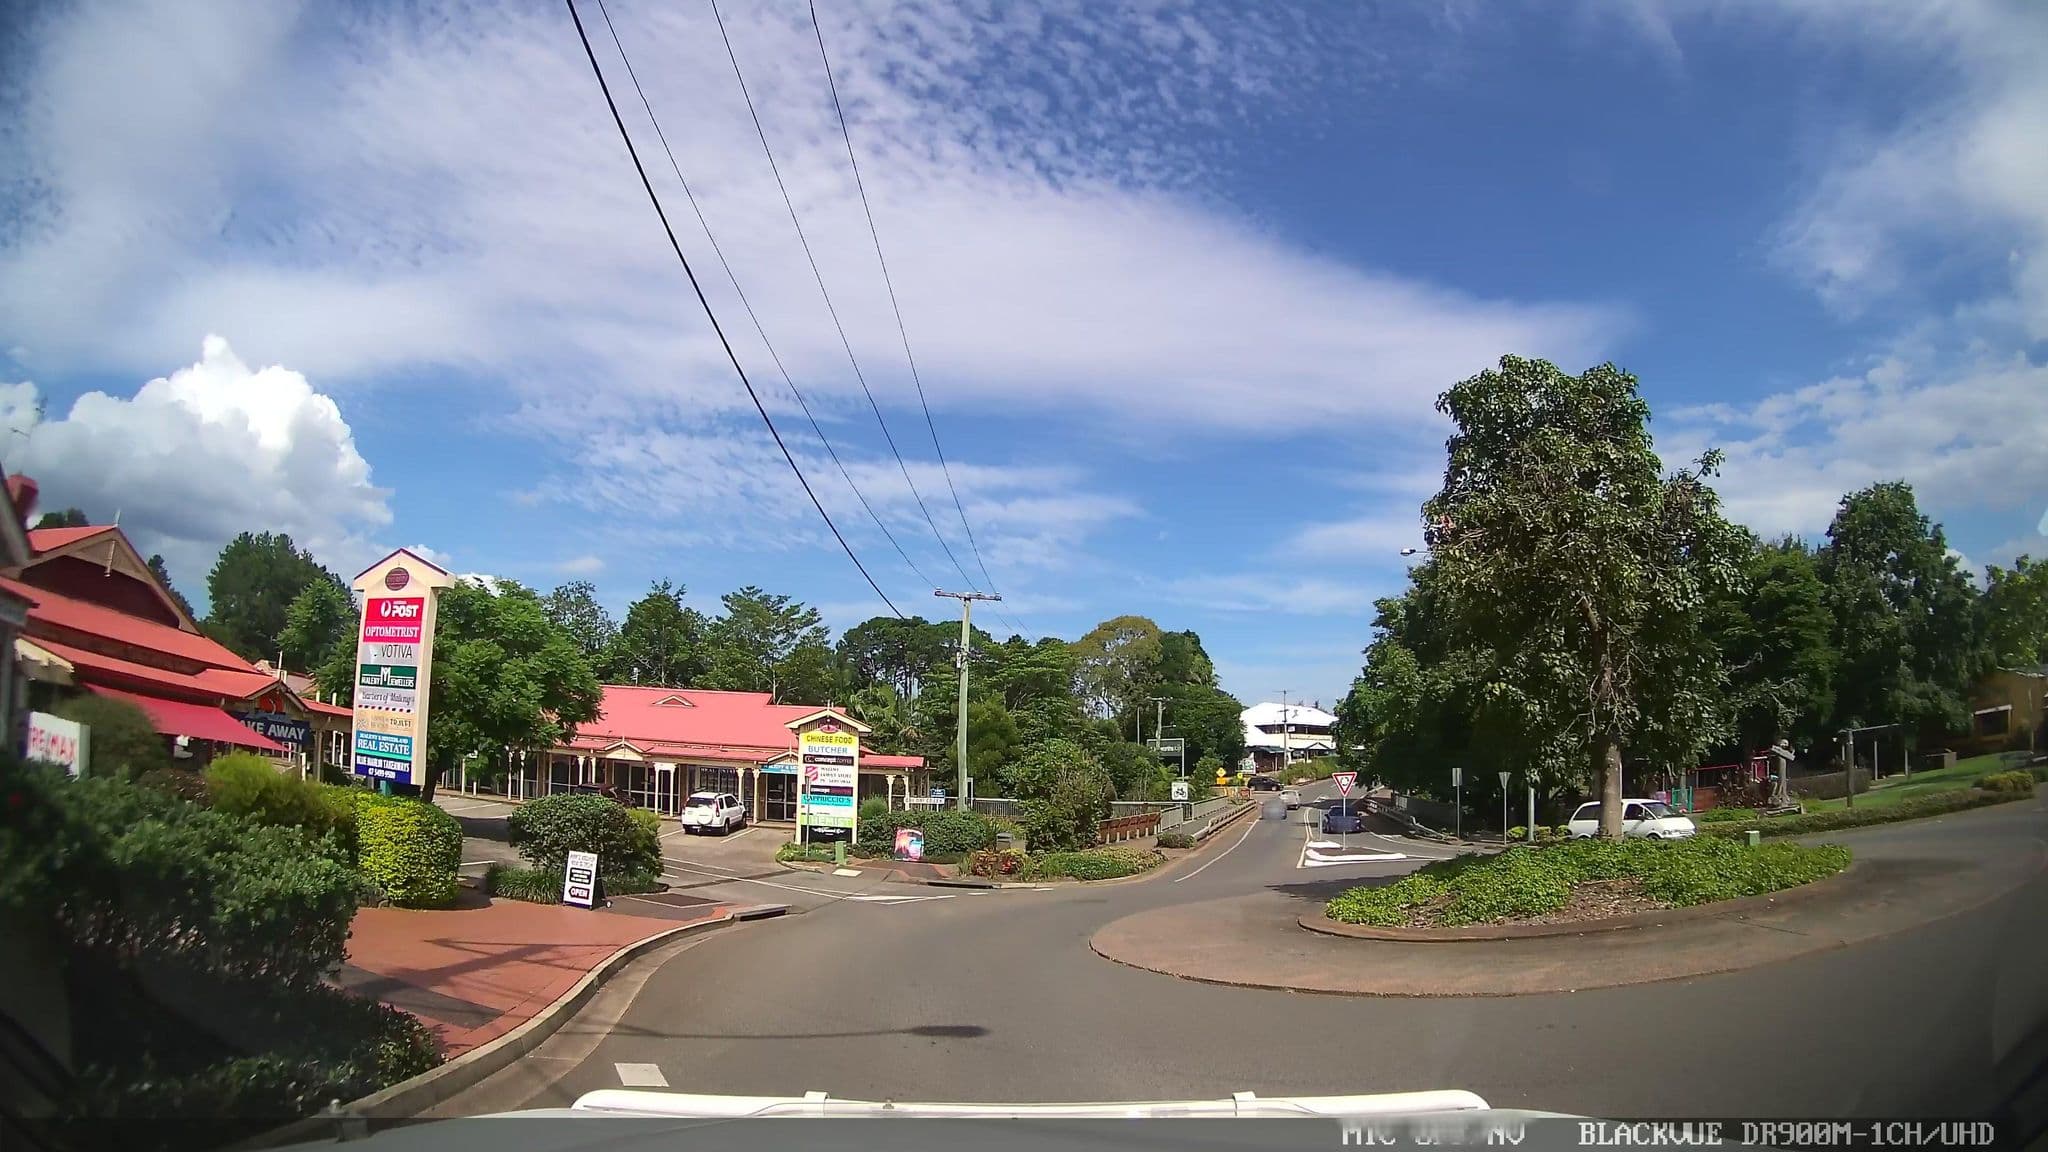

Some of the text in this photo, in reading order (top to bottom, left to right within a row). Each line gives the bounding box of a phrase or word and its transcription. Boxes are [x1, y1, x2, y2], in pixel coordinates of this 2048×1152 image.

[391, 604, 419, 618] POST
[365, 626, 420, 638] OPTOMETRIST
[381, 644, 413, 659] VOTIVA
[389, 677, 415, 687] JEWELLERS
[267, 724, 305, 740] AWAY
[806, 735, 853, 744] CHINESE FOOD
[357, 738, 410, 755] REAL ESTATE
[808, 745, 848, 754] BUTCHER
[571, 888, 588, 898] OPEN
